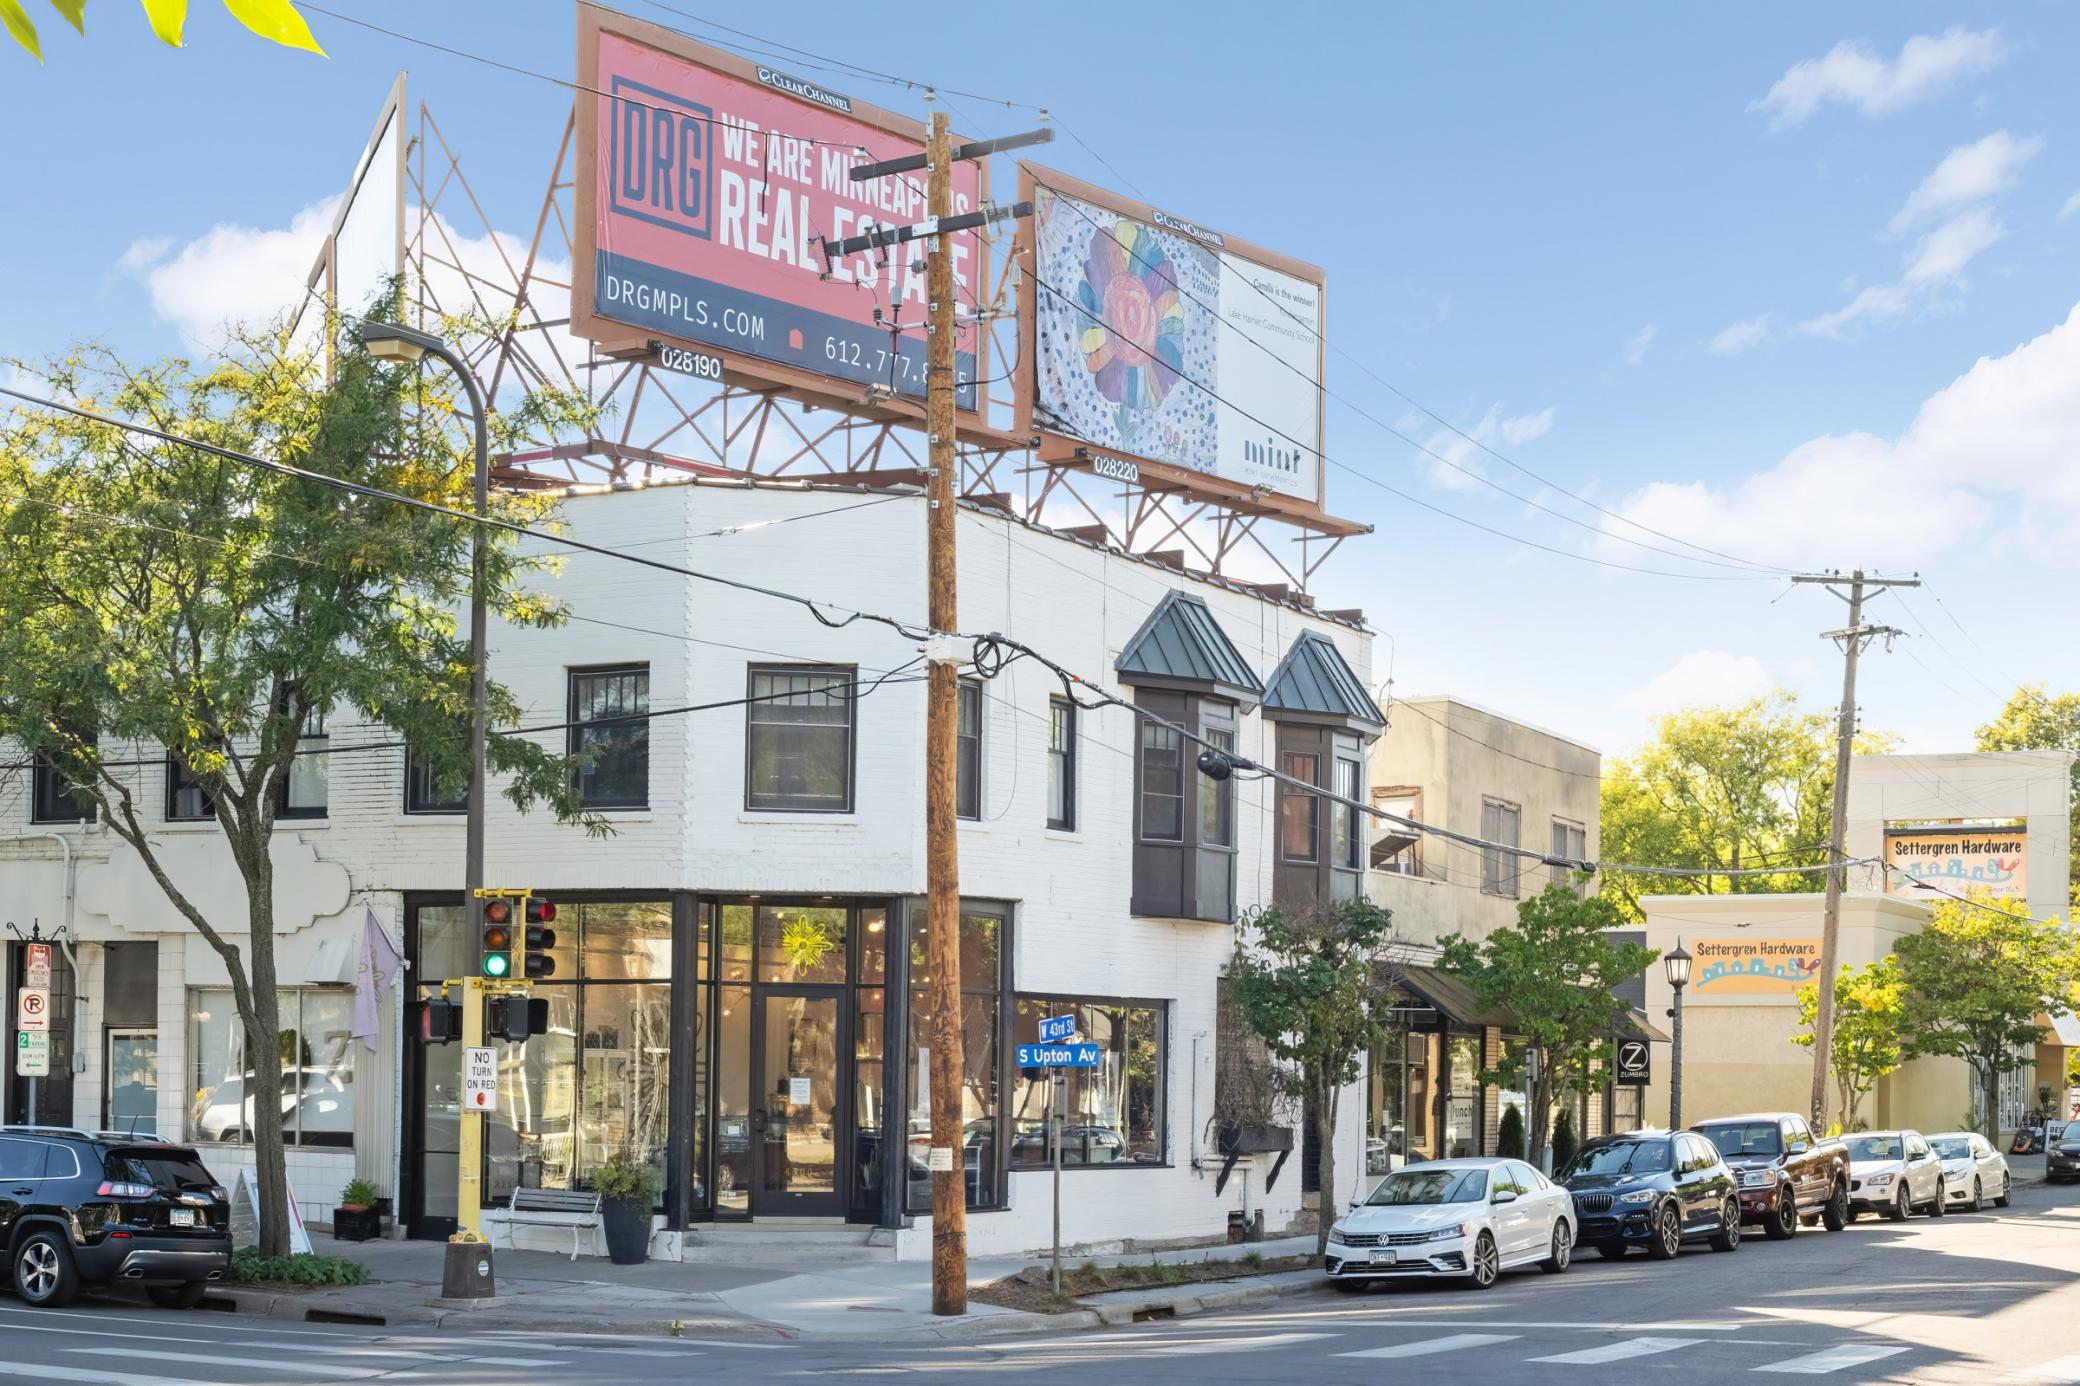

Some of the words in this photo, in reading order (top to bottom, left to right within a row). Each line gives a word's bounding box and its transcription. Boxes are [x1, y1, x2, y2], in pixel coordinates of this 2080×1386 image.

[722, 112, 759, 168] WE
[767, 129, 814, 185] ARE
[623, 101, 702, 218] DRG
[720, 169, 819, 272] REAL
[833, 206, 969, 316] ESTAE
[1275, 287, 1280, 296] is
[1281, 288, 1292, 300] the
[607, 275, 764, 341] DRGMPLS.COM
[661, 347, 721, 379] 028190
[1245, 437, 1301, 474] mint
[1094, 456, 1138, 482] 028220
[1895, 840, 1959, 857] Settergren
[1962, 839, 2022, 854] Hardware
[1697, 942, 1757, 957] Settergren
[1760, 941, 1815, 955] Hardware
[1041, 1024, 1047, 1039] W
[1050, 1021, 1065, 1037] 43rd
[1066, 1018, 1074, 1033] St
[20, 1033, 28, 1047] 2
[474, 1051, 490, 1064] NO
[1019, 1048, 1028, 1063] S
[1033, 1048, 1072, 1066] Upton
[1078, 1047, 1096, 1062] Av
[472, 1066, 493, 1077] TURN
[467, 1079, 478, 1089] ON
[481, 1080, 496, 1090] RED
